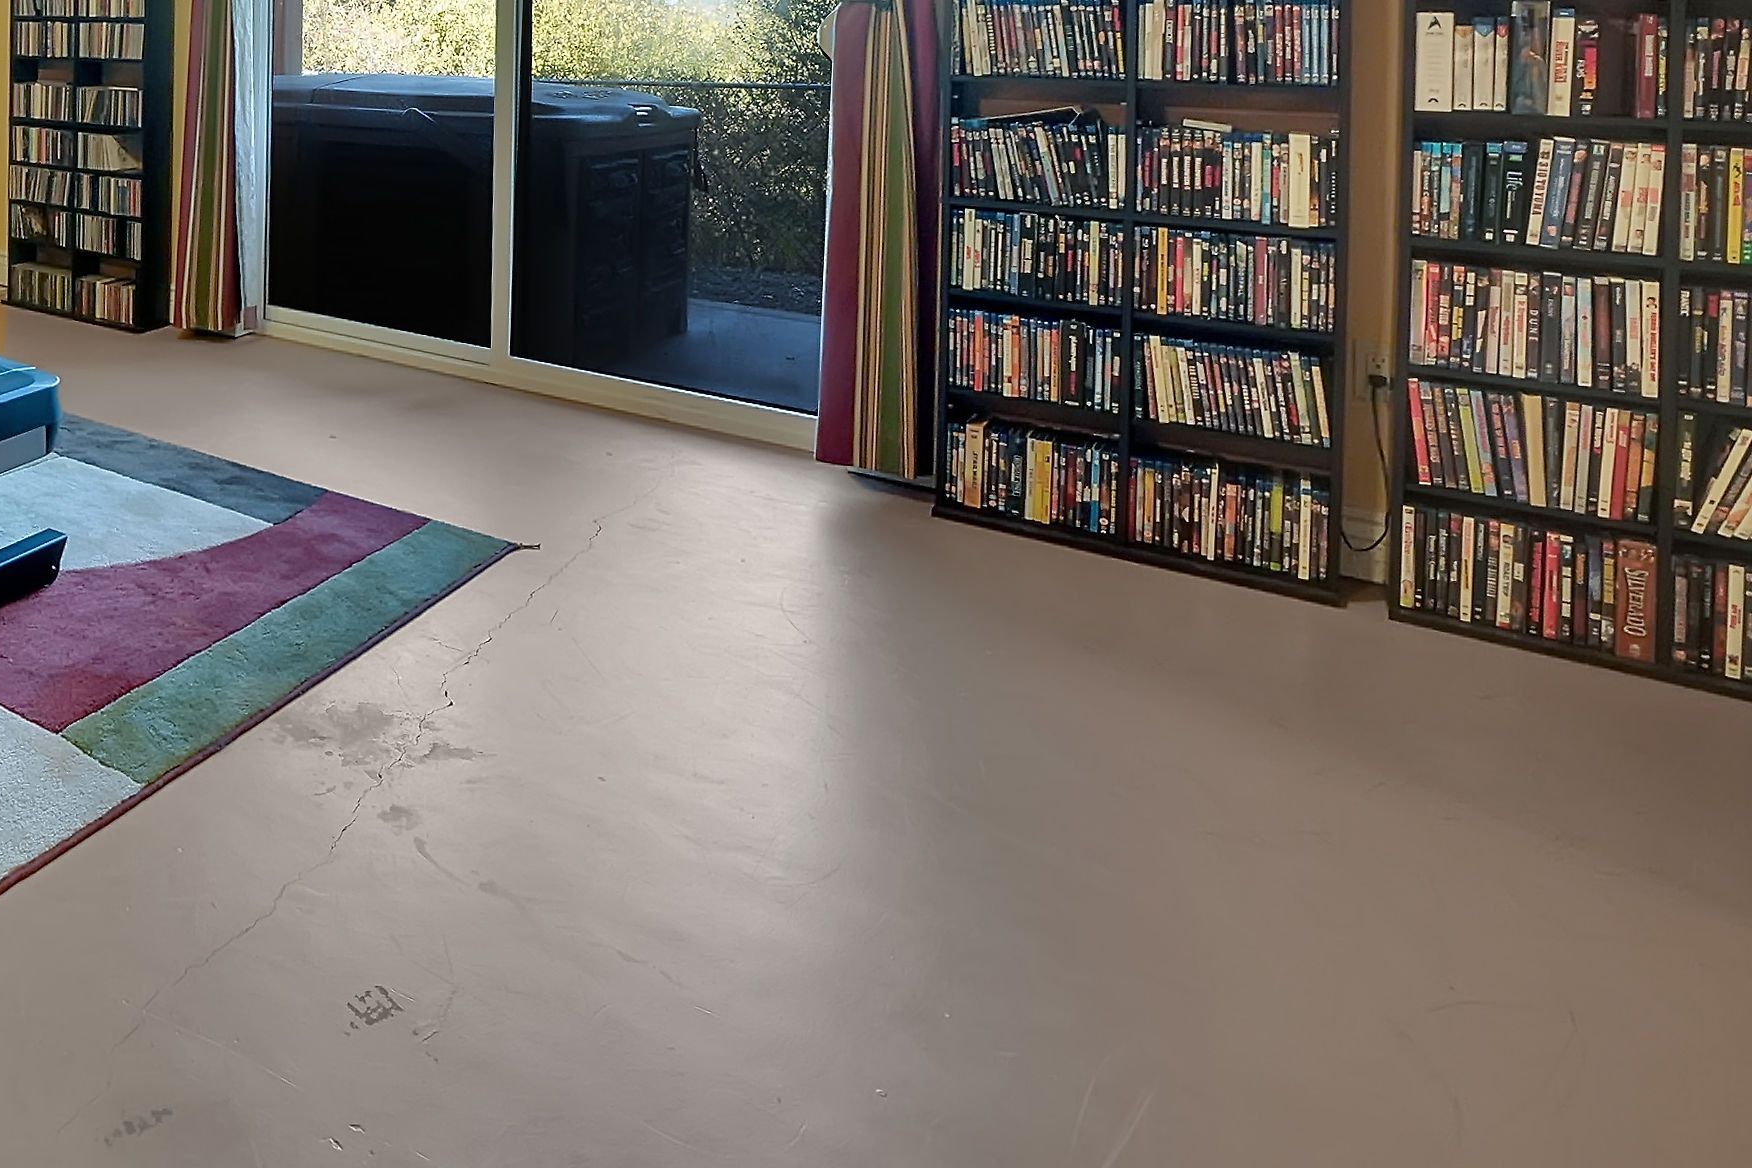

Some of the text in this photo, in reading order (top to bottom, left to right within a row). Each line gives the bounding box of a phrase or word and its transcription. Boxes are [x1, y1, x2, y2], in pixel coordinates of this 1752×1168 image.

[1555, 41, 1565, 61] RIVER
[1506, 170, 1524, 191] Life
[1532, 191, 1545, 216] YUMA
[1529, 309, 1539, 342] DUNE
[1623, 567, 1649, 637] SILVERADO
